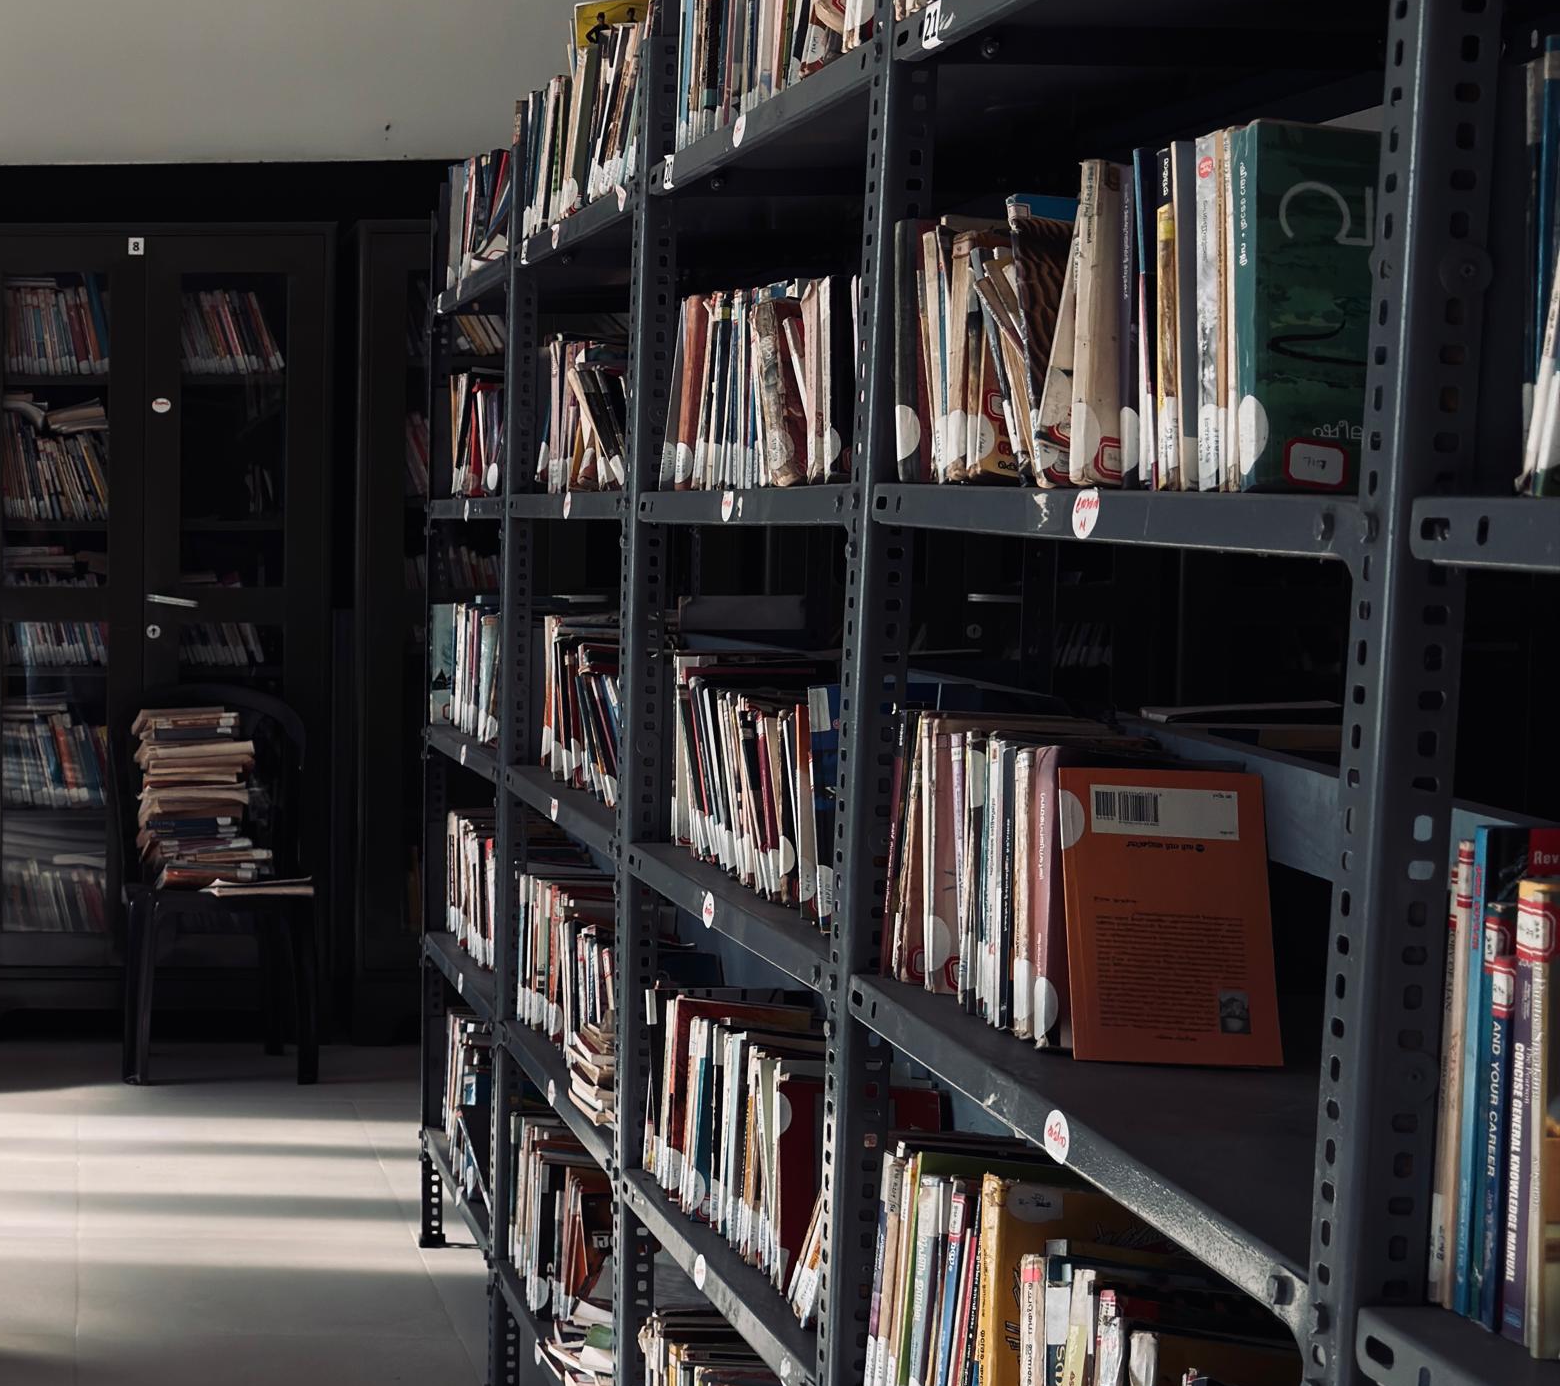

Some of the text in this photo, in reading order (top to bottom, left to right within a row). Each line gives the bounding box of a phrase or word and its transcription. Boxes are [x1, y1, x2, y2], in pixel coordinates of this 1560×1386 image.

[924, 8, 938, 42] 21
[132, 241, 140, 252] 8
[1491, 1021, 1502, 1055] AND
[1489, 1061, 1501, 1105] YOUR
[1486, 1110, 1499, 1177] CAREER
[1504, 1042, 1525, 1282] CONCISE GENERAL KNOWLEDGE MANUAL
